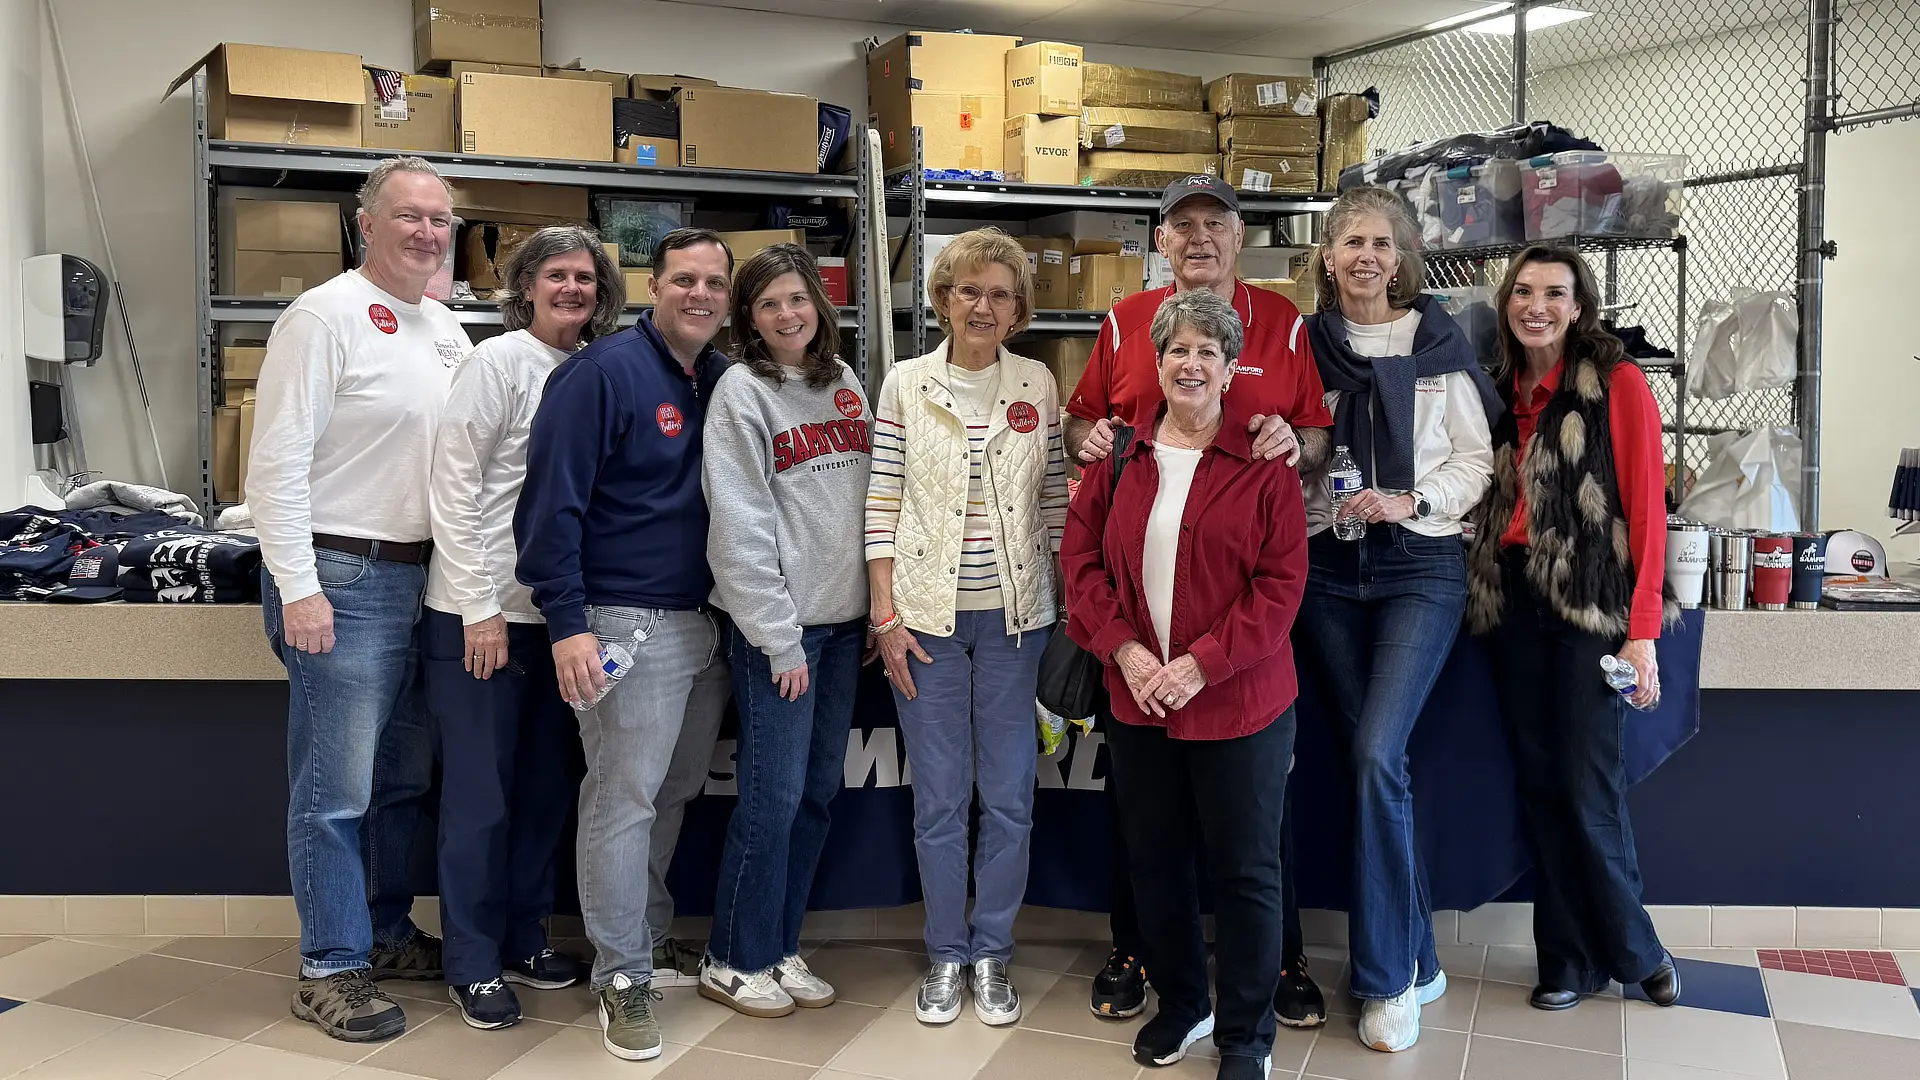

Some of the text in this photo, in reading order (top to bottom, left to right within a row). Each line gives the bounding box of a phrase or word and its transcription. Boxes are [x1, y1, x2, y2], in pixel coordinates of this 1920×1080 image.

[1012, 77, 1035, 88] VEVOR
[1035, 146, 1068, 157] VEVOR
[1236, 365, 1264, 373] AMFORD
[773, 419, 872, 474] SAMFORD
[811, 458, 860, 473] UNIVERSITY
